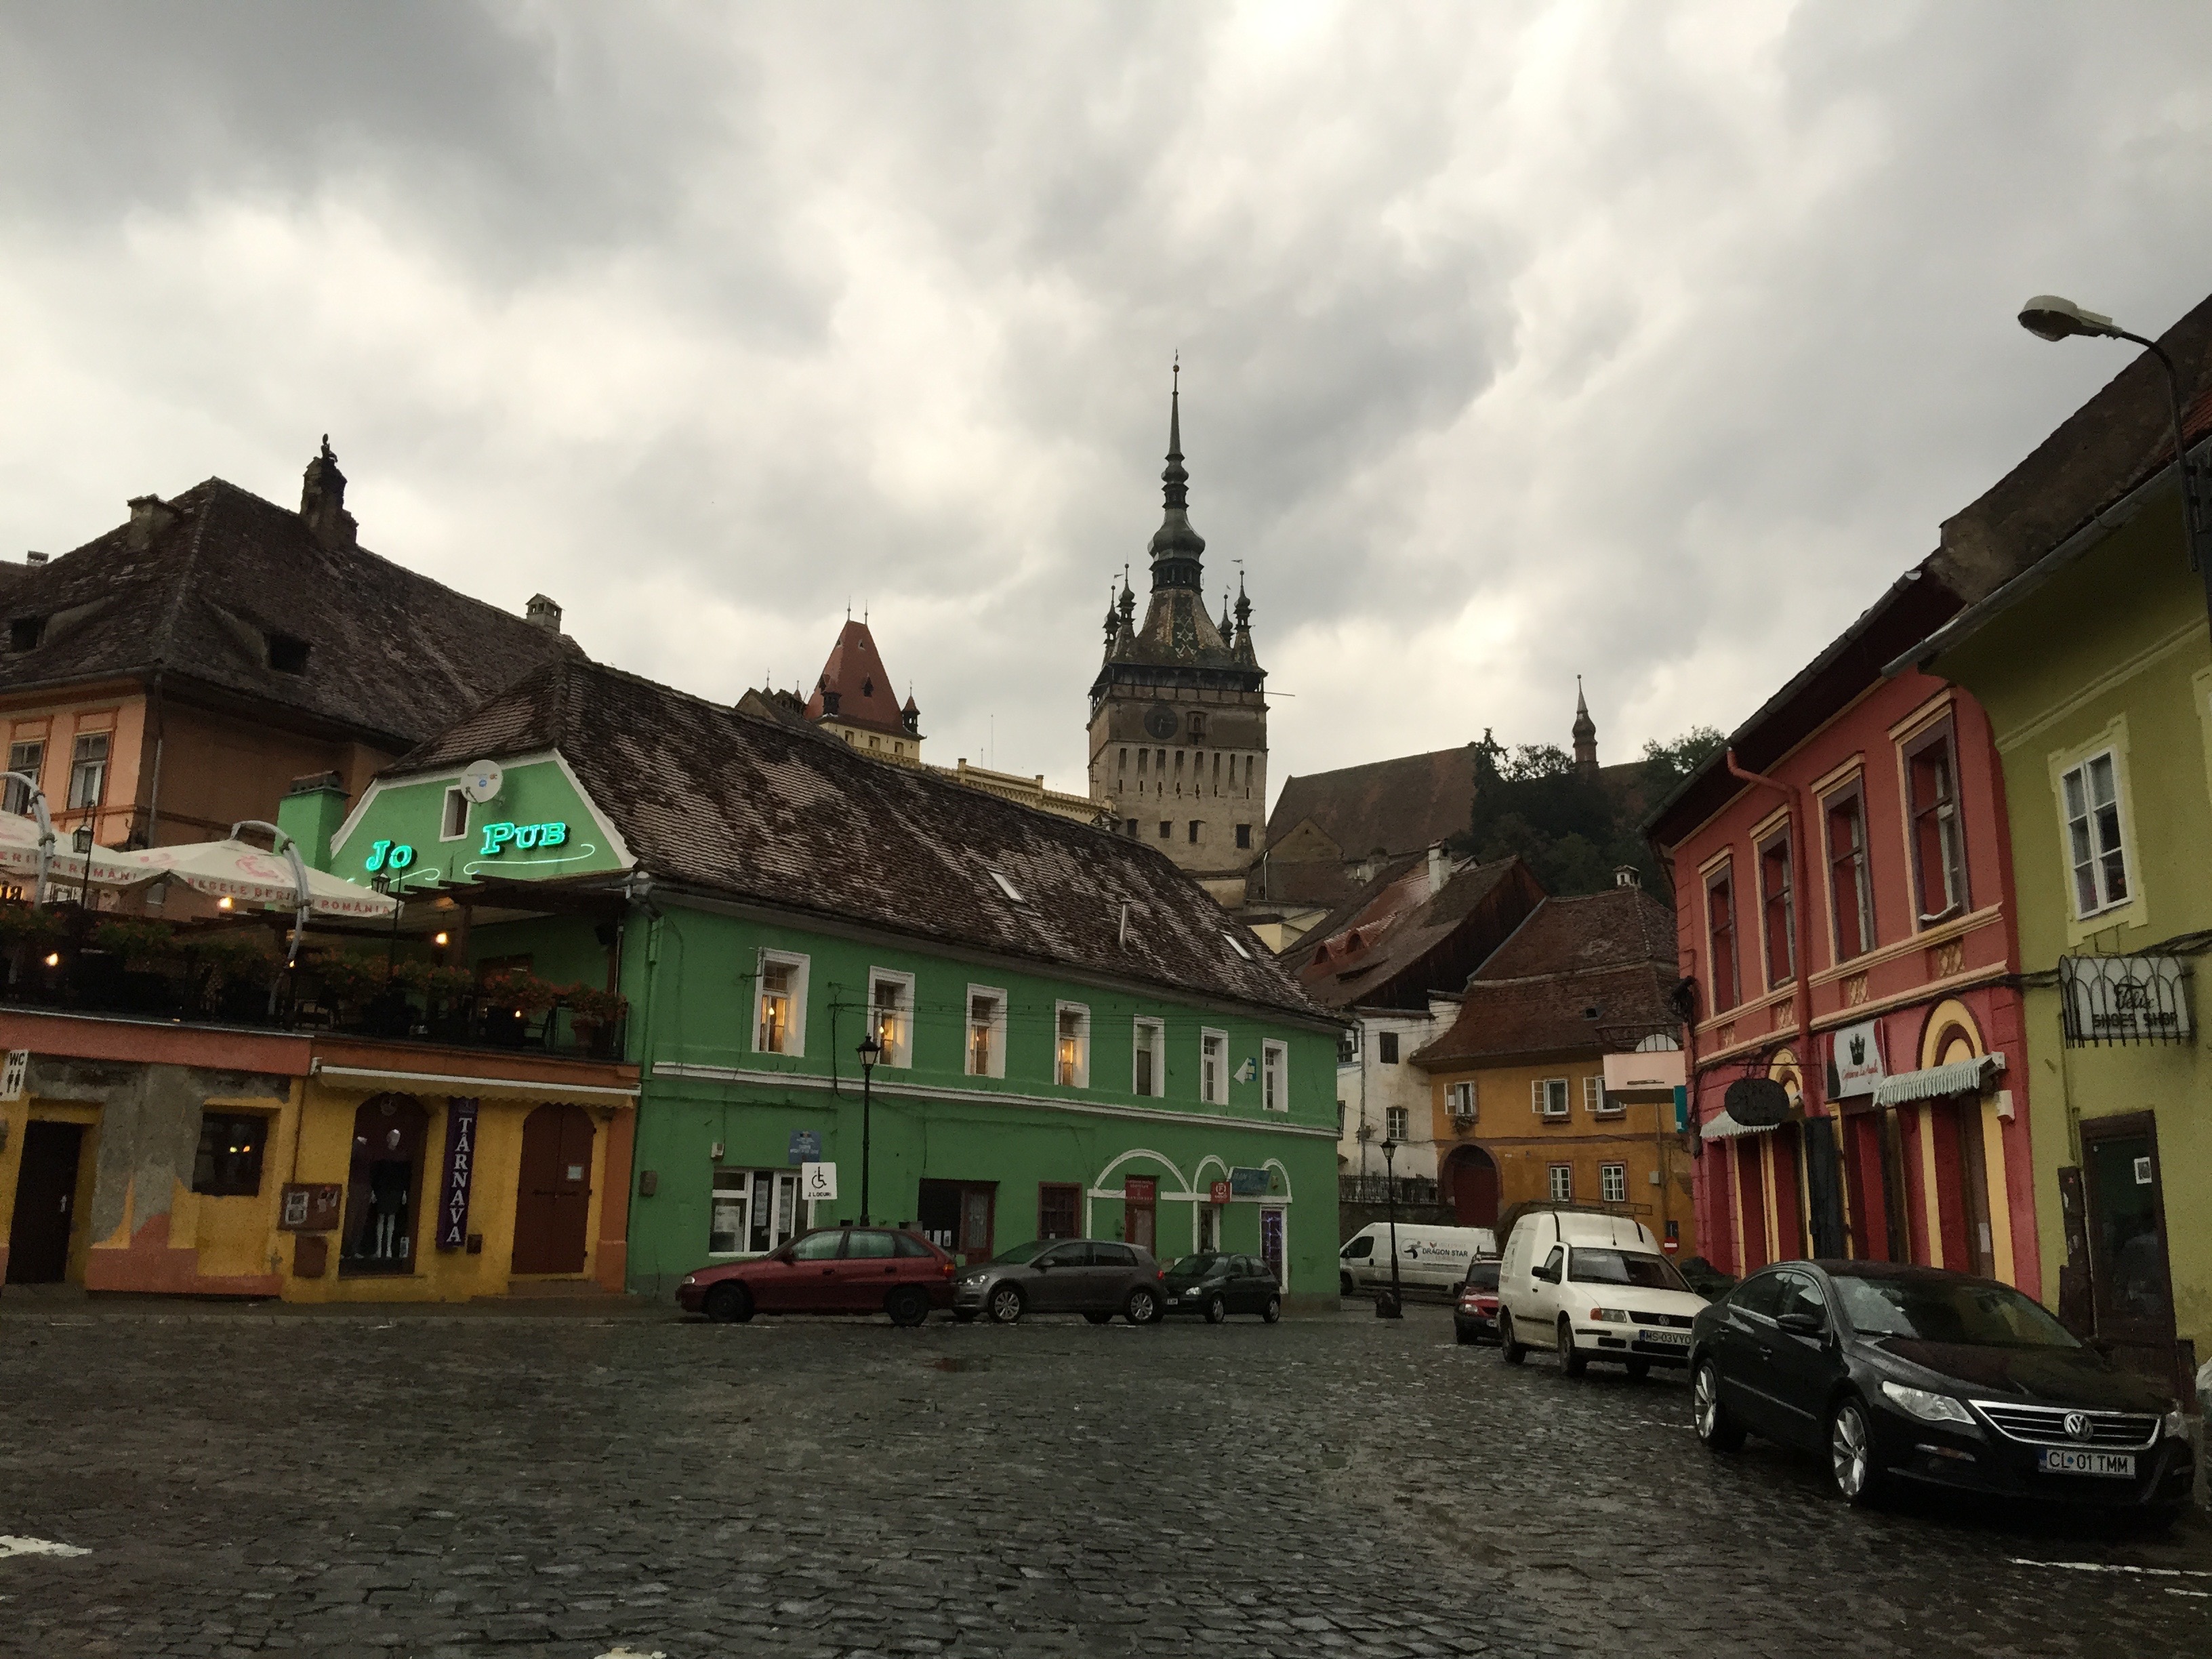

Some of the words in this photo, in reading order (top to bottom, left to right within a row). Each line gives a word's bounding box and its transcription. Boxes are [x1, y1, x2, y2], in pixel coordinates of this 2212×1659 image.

[322, 899, 390, 915] ROMÂNIA
[2091, 1013, 2137, 1027] SHOES
[2143, 1012, 2179, 1027] SHOP
[9, 1052, 25, 1066] WC
[1422, 1247, 1450, 1256] DRAGON
[2049, 1452, 2070, 1469] CL
[2097, 1455, 2129, 1473] TMM
